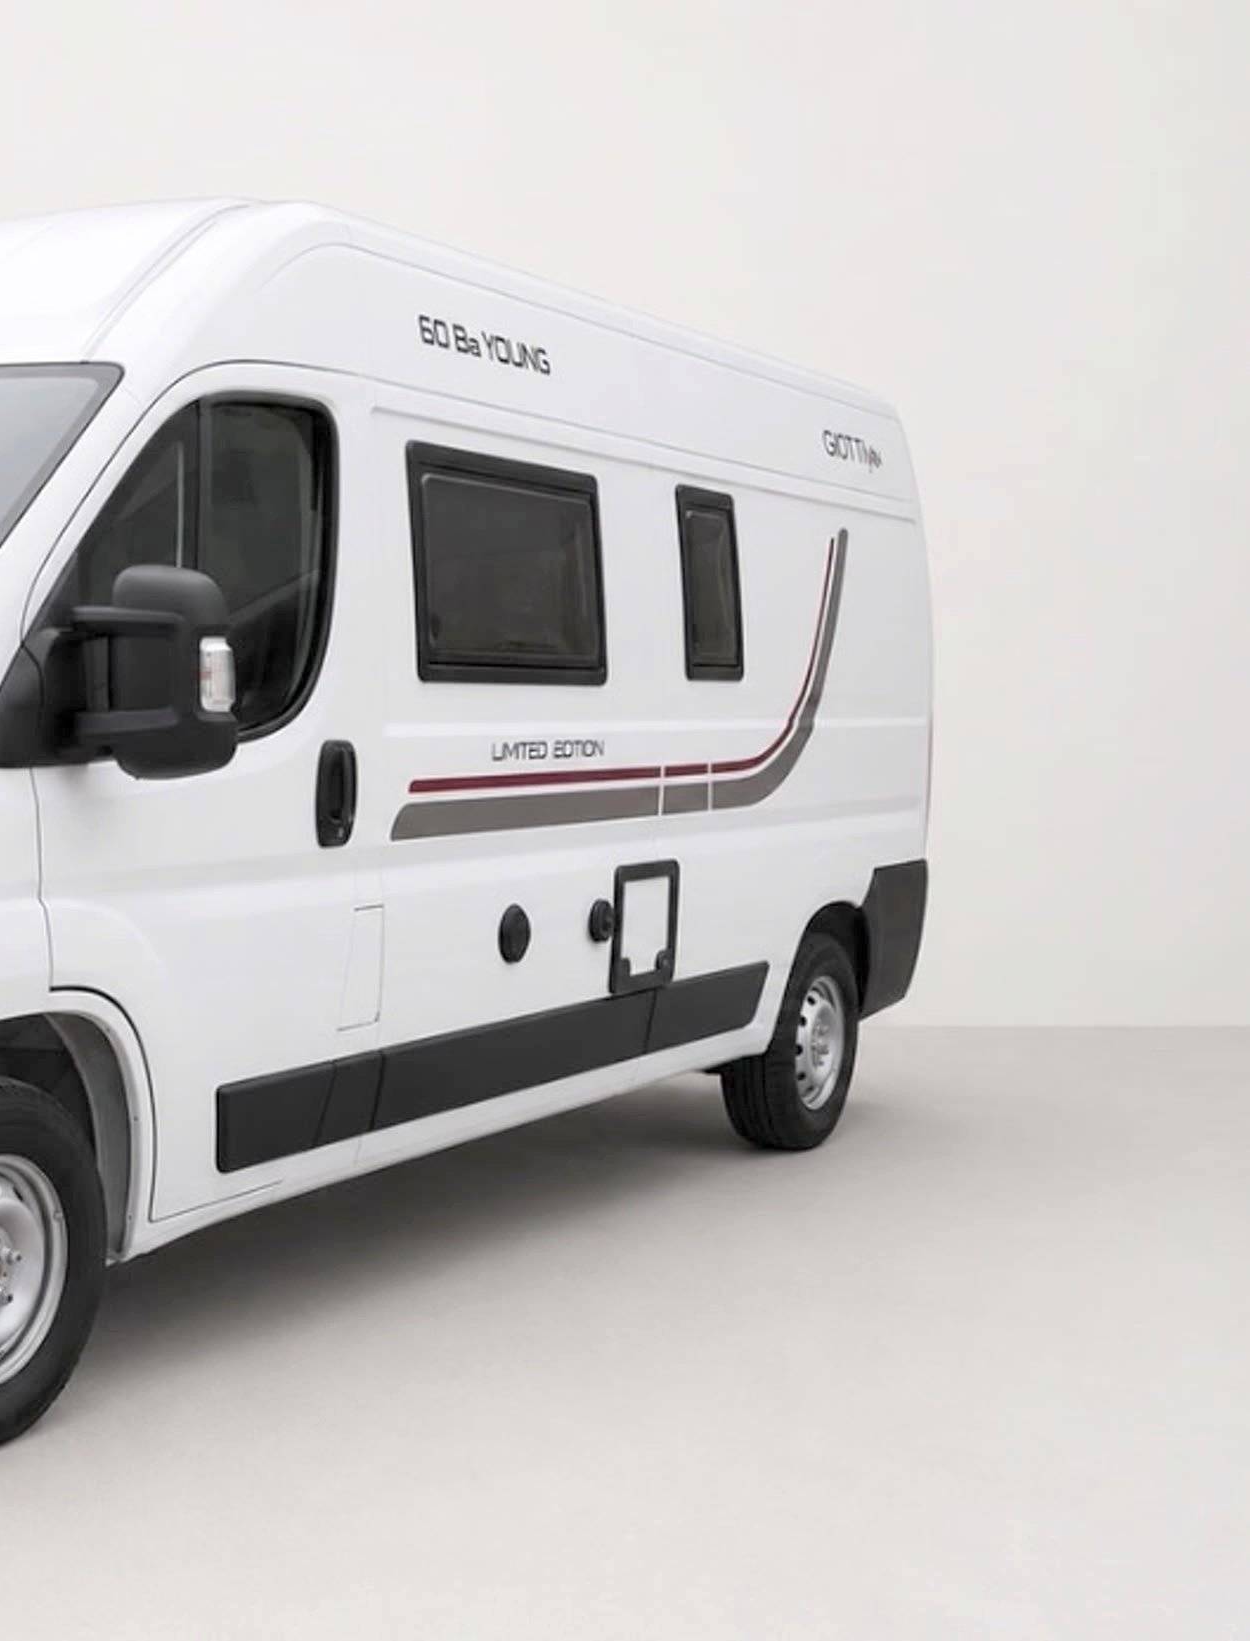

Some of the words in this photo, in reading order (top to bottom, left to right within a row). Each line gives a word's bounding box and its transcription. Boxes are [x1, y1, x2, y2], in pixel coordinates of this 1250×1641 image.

[418, 314, 451, 349] 60
[452, 323, 482, 358] Ba
[481, 330, 551, 376] YOUNG
